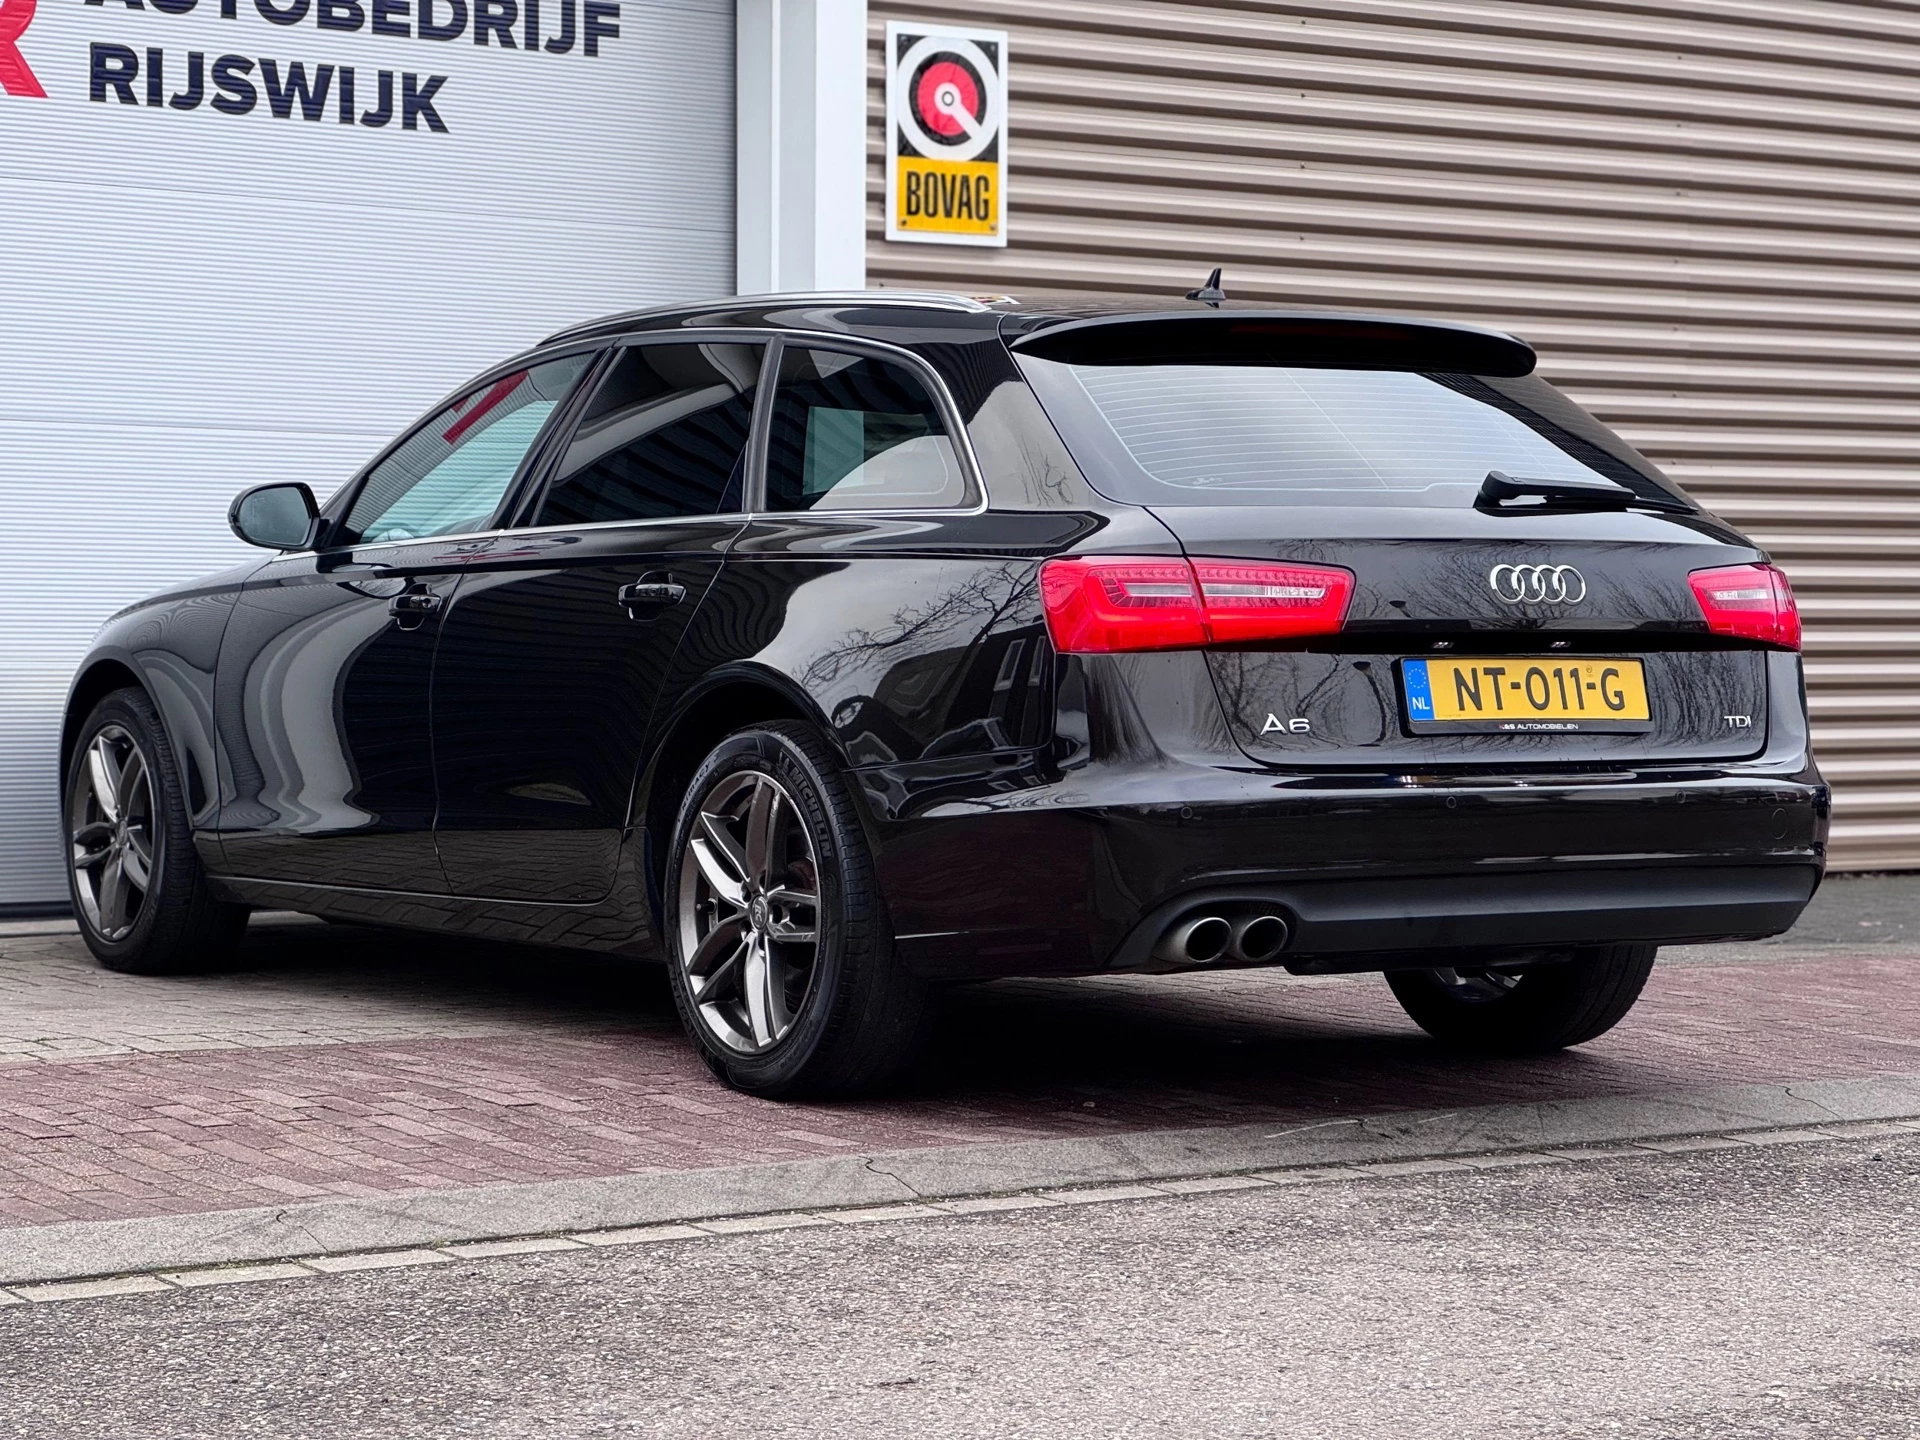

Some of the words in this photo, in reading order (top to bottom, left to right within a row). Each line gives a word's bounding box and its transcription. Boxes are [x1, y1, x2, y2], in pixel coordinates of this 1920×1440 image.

[84, 0, 620, 57] BEDRIJF
[89, 42, 450, 133] RIJSWIJK
[906, 171, 990, 221] BOVAG
[1412, 696, 1430, 710] NL
[1453, 666, 1626, 711] NT-011-G
[1260, 712, 1311, 735] A6
[1723, 715, 1752, 728] TDI
[789, 766, 832, 858] MICHELIN
